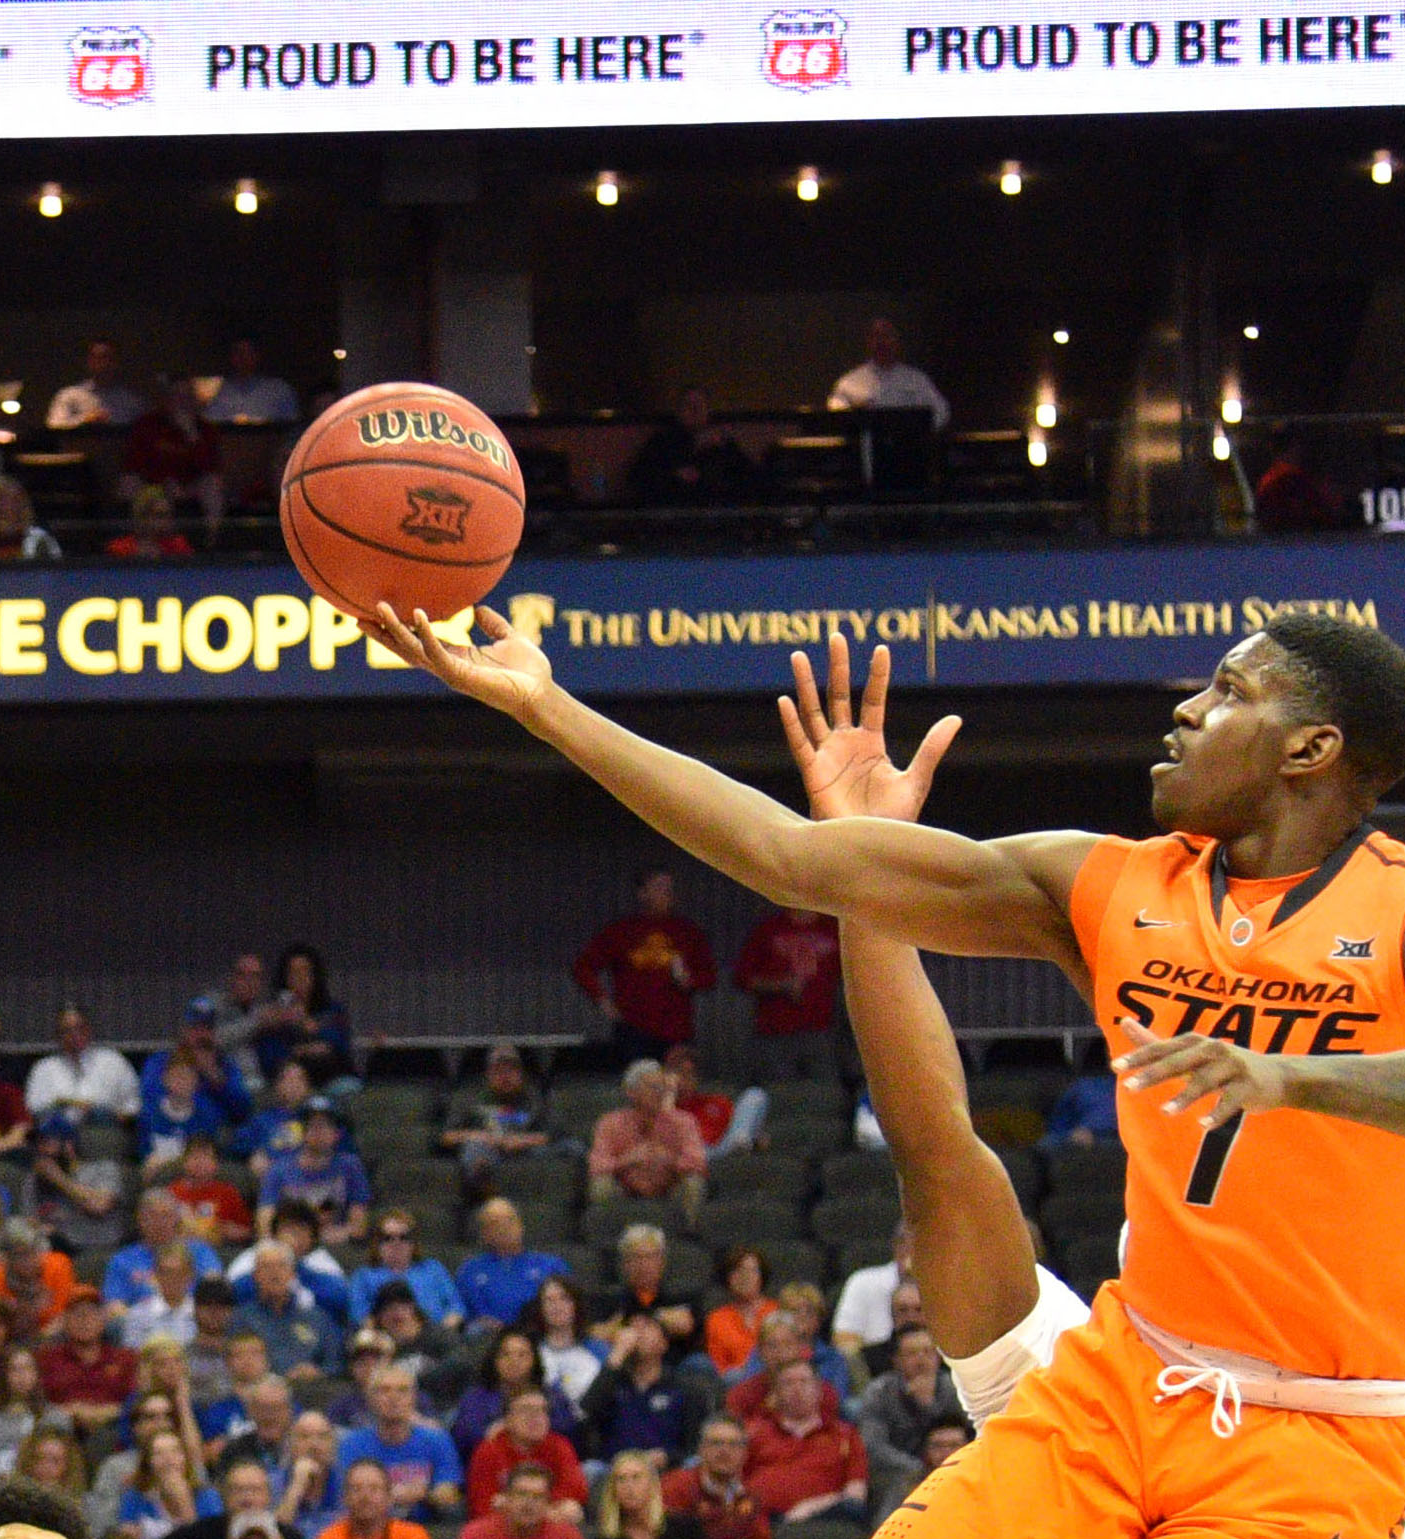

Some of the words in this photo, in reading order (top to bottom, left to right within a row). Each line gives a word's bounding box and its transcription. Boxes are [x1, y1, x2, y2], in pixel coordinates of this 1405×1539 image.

[208, 42, 377, 90] PROUD
[396, 40, 458, 87] TO
[475, 38, 536, 85] BE
[557, 34, 685, 84] HERE
[776, 43, 837, 75] 66
[905, 23, 1079, 74] PROUD
[1095, 22, 1161, 69] TO
[1176, 18, 1241, 66] BE
[1260, 14, 1392, 65] HERE
[82, 60, 142, 91] 66
[357, 410, 511, 472] Wilson
[1141, 958, 1356, 1005] OKLAHOMA
[1113, 981, 1381, 1057] STATE
